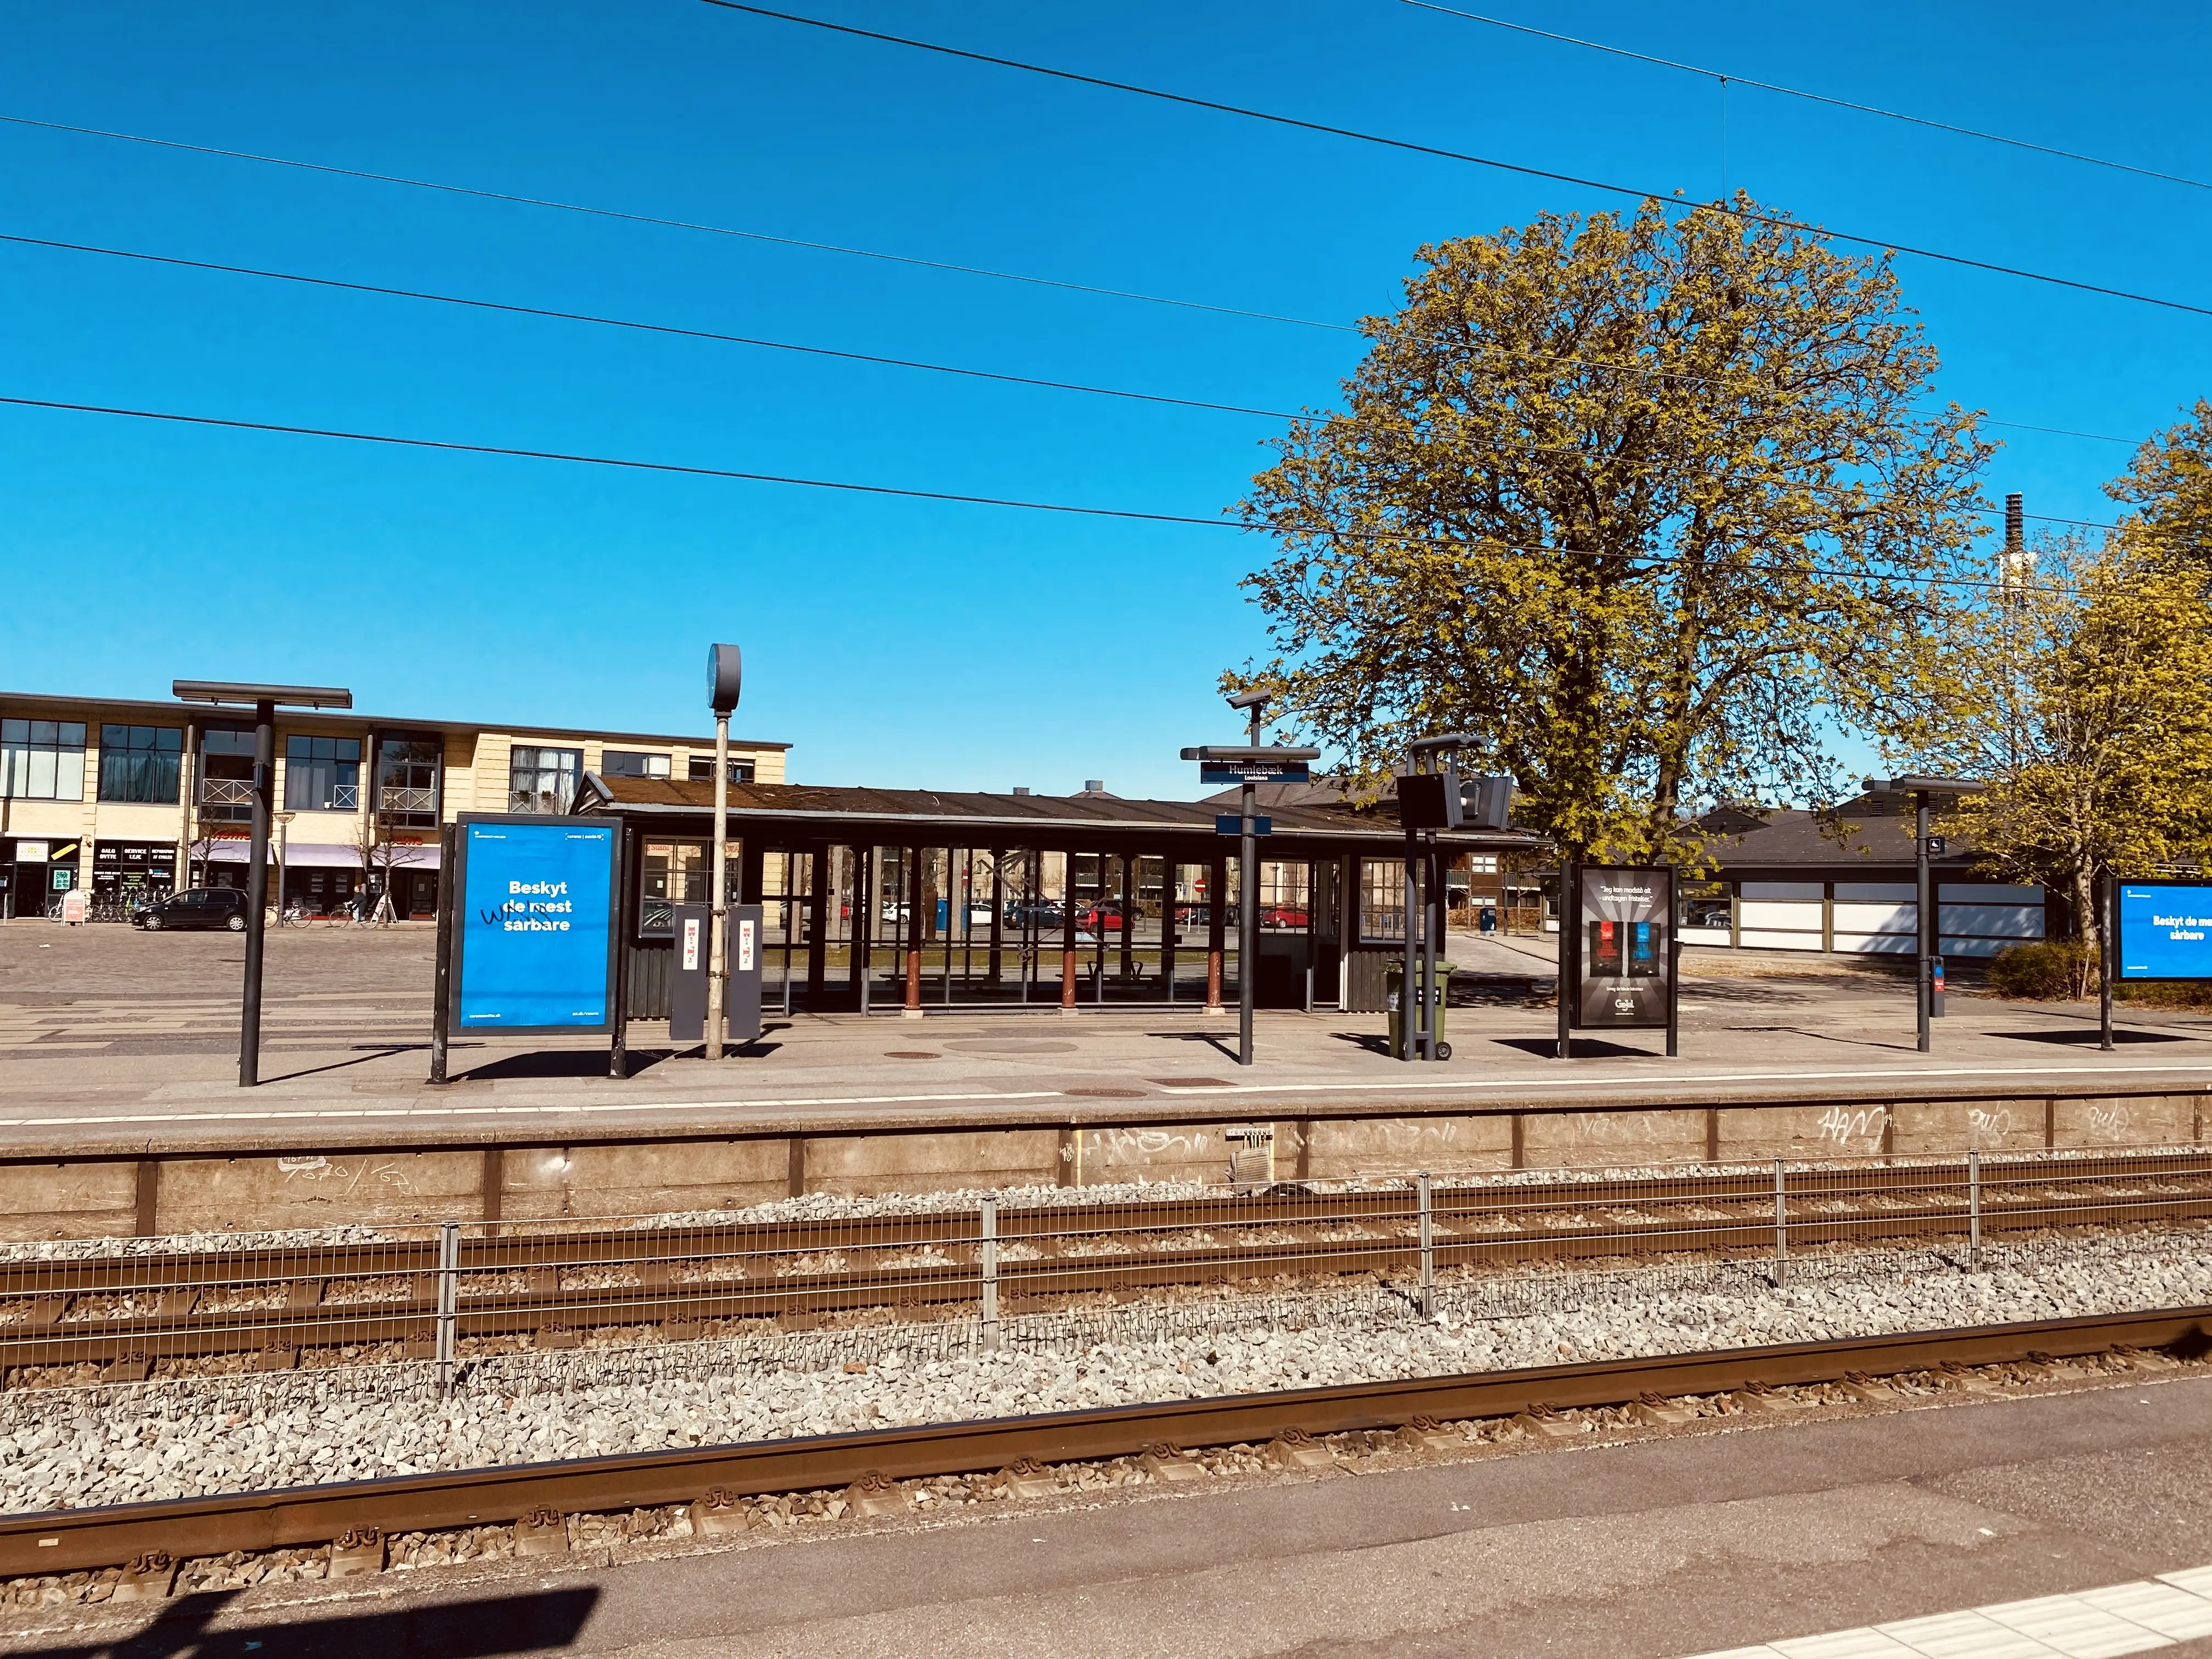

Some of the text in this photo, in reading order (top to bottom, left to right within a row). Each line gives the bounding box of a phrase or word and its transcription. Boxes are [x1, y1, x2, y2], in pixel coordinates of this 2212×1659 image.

[1229, 765, 1283, 775] Humlebæk
[509, 881, 567, 898] Beskyt
[503, 899, 526, 913] de
[529, 900, 572, 913] mest
[2153, 915, 2184, 929] Beskyt
[2185, 916, 2197, 926] de
[2170, 929, 2205, 940] sårbare
